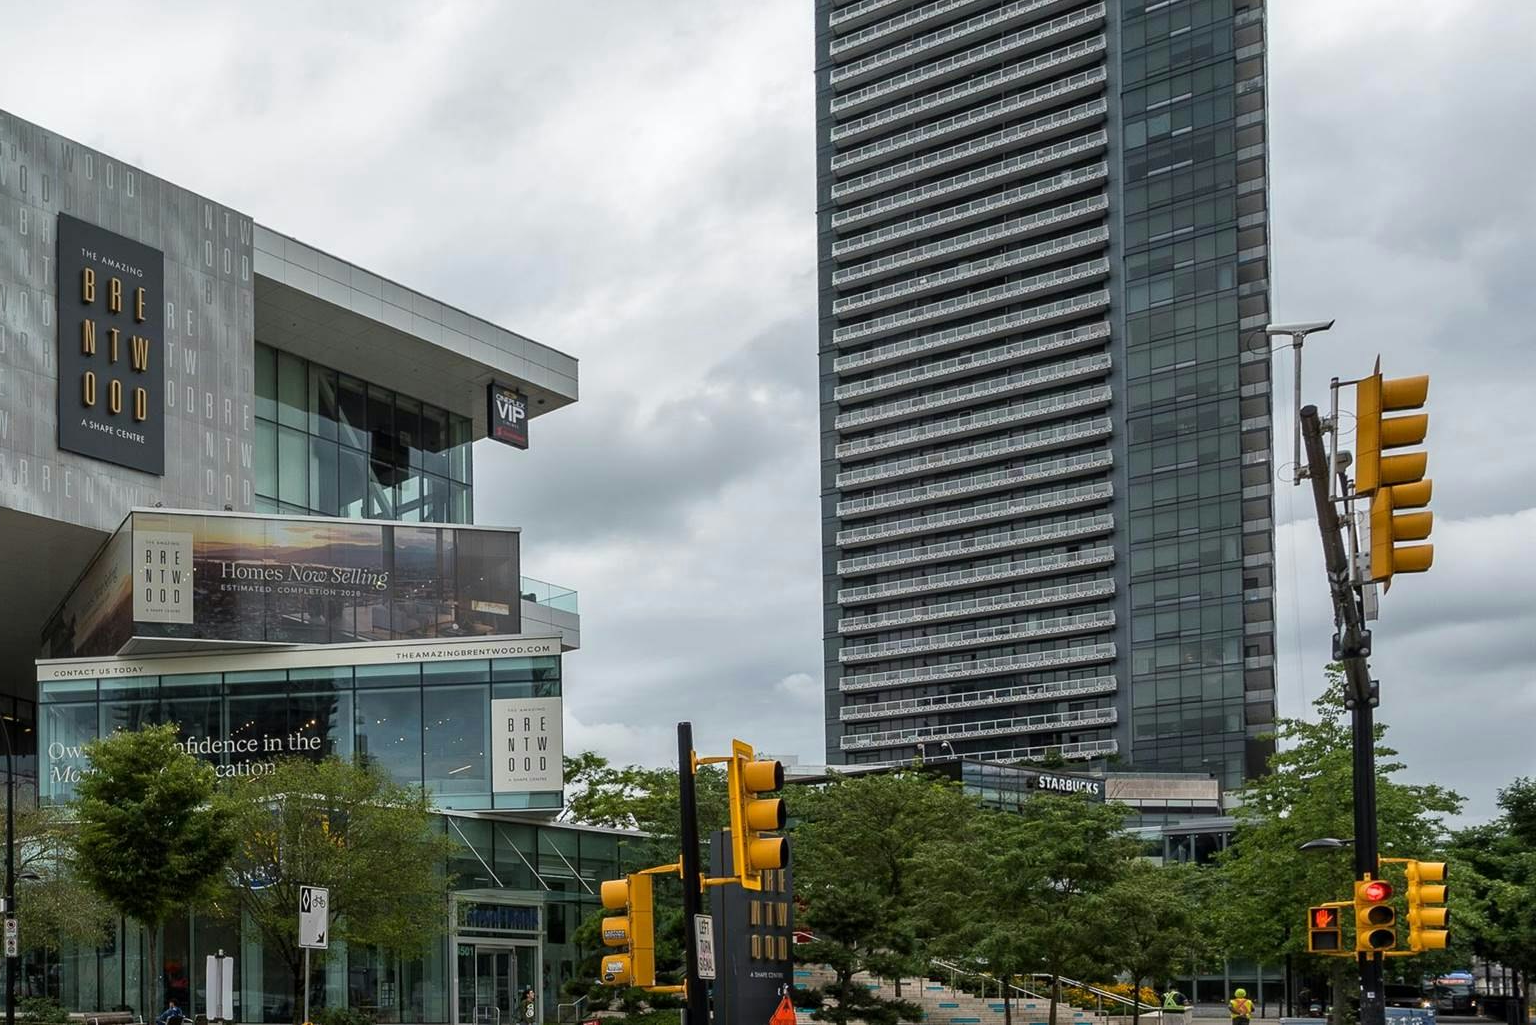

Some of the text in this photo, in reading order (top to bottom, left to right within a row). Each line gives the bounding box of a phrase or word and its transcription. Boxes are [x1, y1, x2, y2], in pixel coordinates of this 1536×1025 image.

[81, 248, 144, 278] THE AMAZING
[496, 399, 526, 424] VIP
[81, 418, 146, 445] A SHAPE CENTRE
[221, 563, 389, 591] Homes Now Selling
[220, 584, 272, 594] ESTIMATED
[277, 587, 336, 597] COMPLETION
[396, 645, 551, 659] THEAMAZINGBRENTWOOD.COM
[54, 669, 96, 677] CONTACT
[113, 666, 144, 674] TODAY
[263, 734, 282, 752] in
[287, 732, 321, 751] the
[1039, 775, 1099, 795] STARBUCKS
